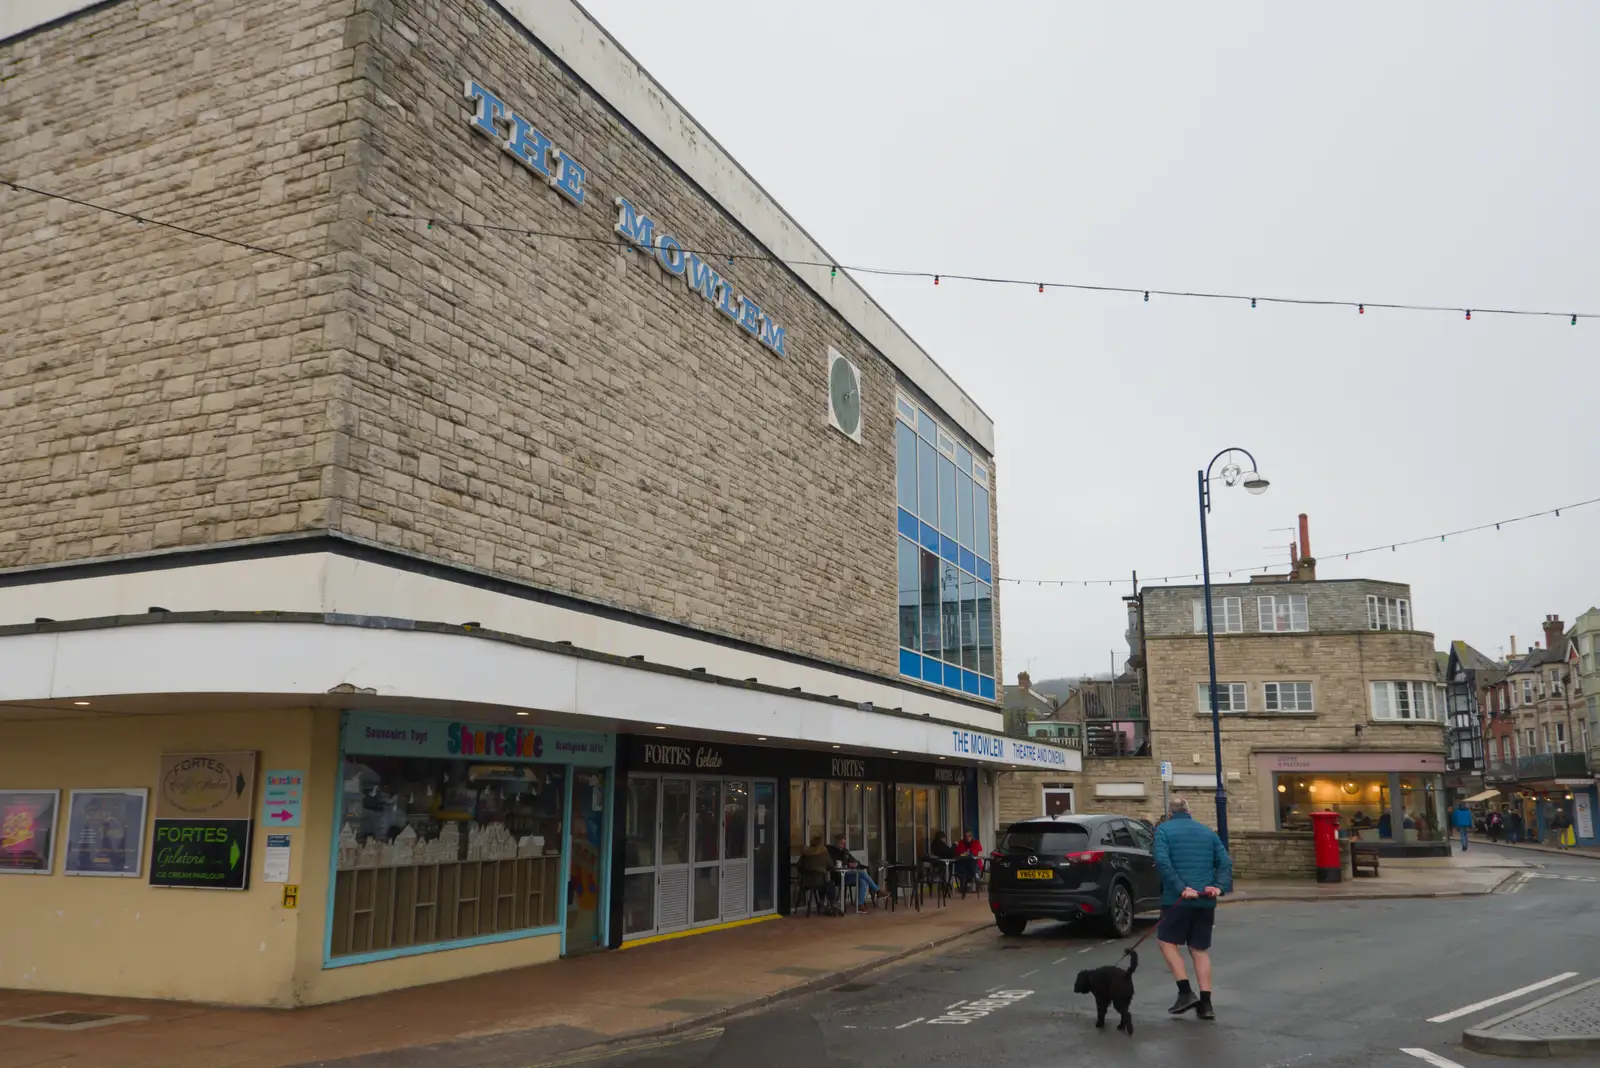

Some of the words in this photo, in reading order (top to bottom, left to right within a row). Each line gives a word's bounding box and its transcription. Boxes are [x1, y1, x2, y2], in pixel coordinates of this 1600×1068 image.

[464, 80, 586, 206] THE
[614, 197, 787, 357] MOWLEM
[410, 729, 428, 745] Toys
[447, 722, 543, 758] ShoreSide
[643, 744, 691, 766] FORTES
[695, 746, 722, 768] Gelato
[952, 731, 969, 753] THE
[971, 733, 1004, 758] MOWLEM
[1012, 743, 1036, 761] THEATRE
[1037, 748, 1047, 763] AND
[1048, 750, 1065, 766] CINEMA
[173, 757, 225, 777] FORTES
[831, 758, 865, 778] FORTES
[157, 827, 228, 843] FORTES
